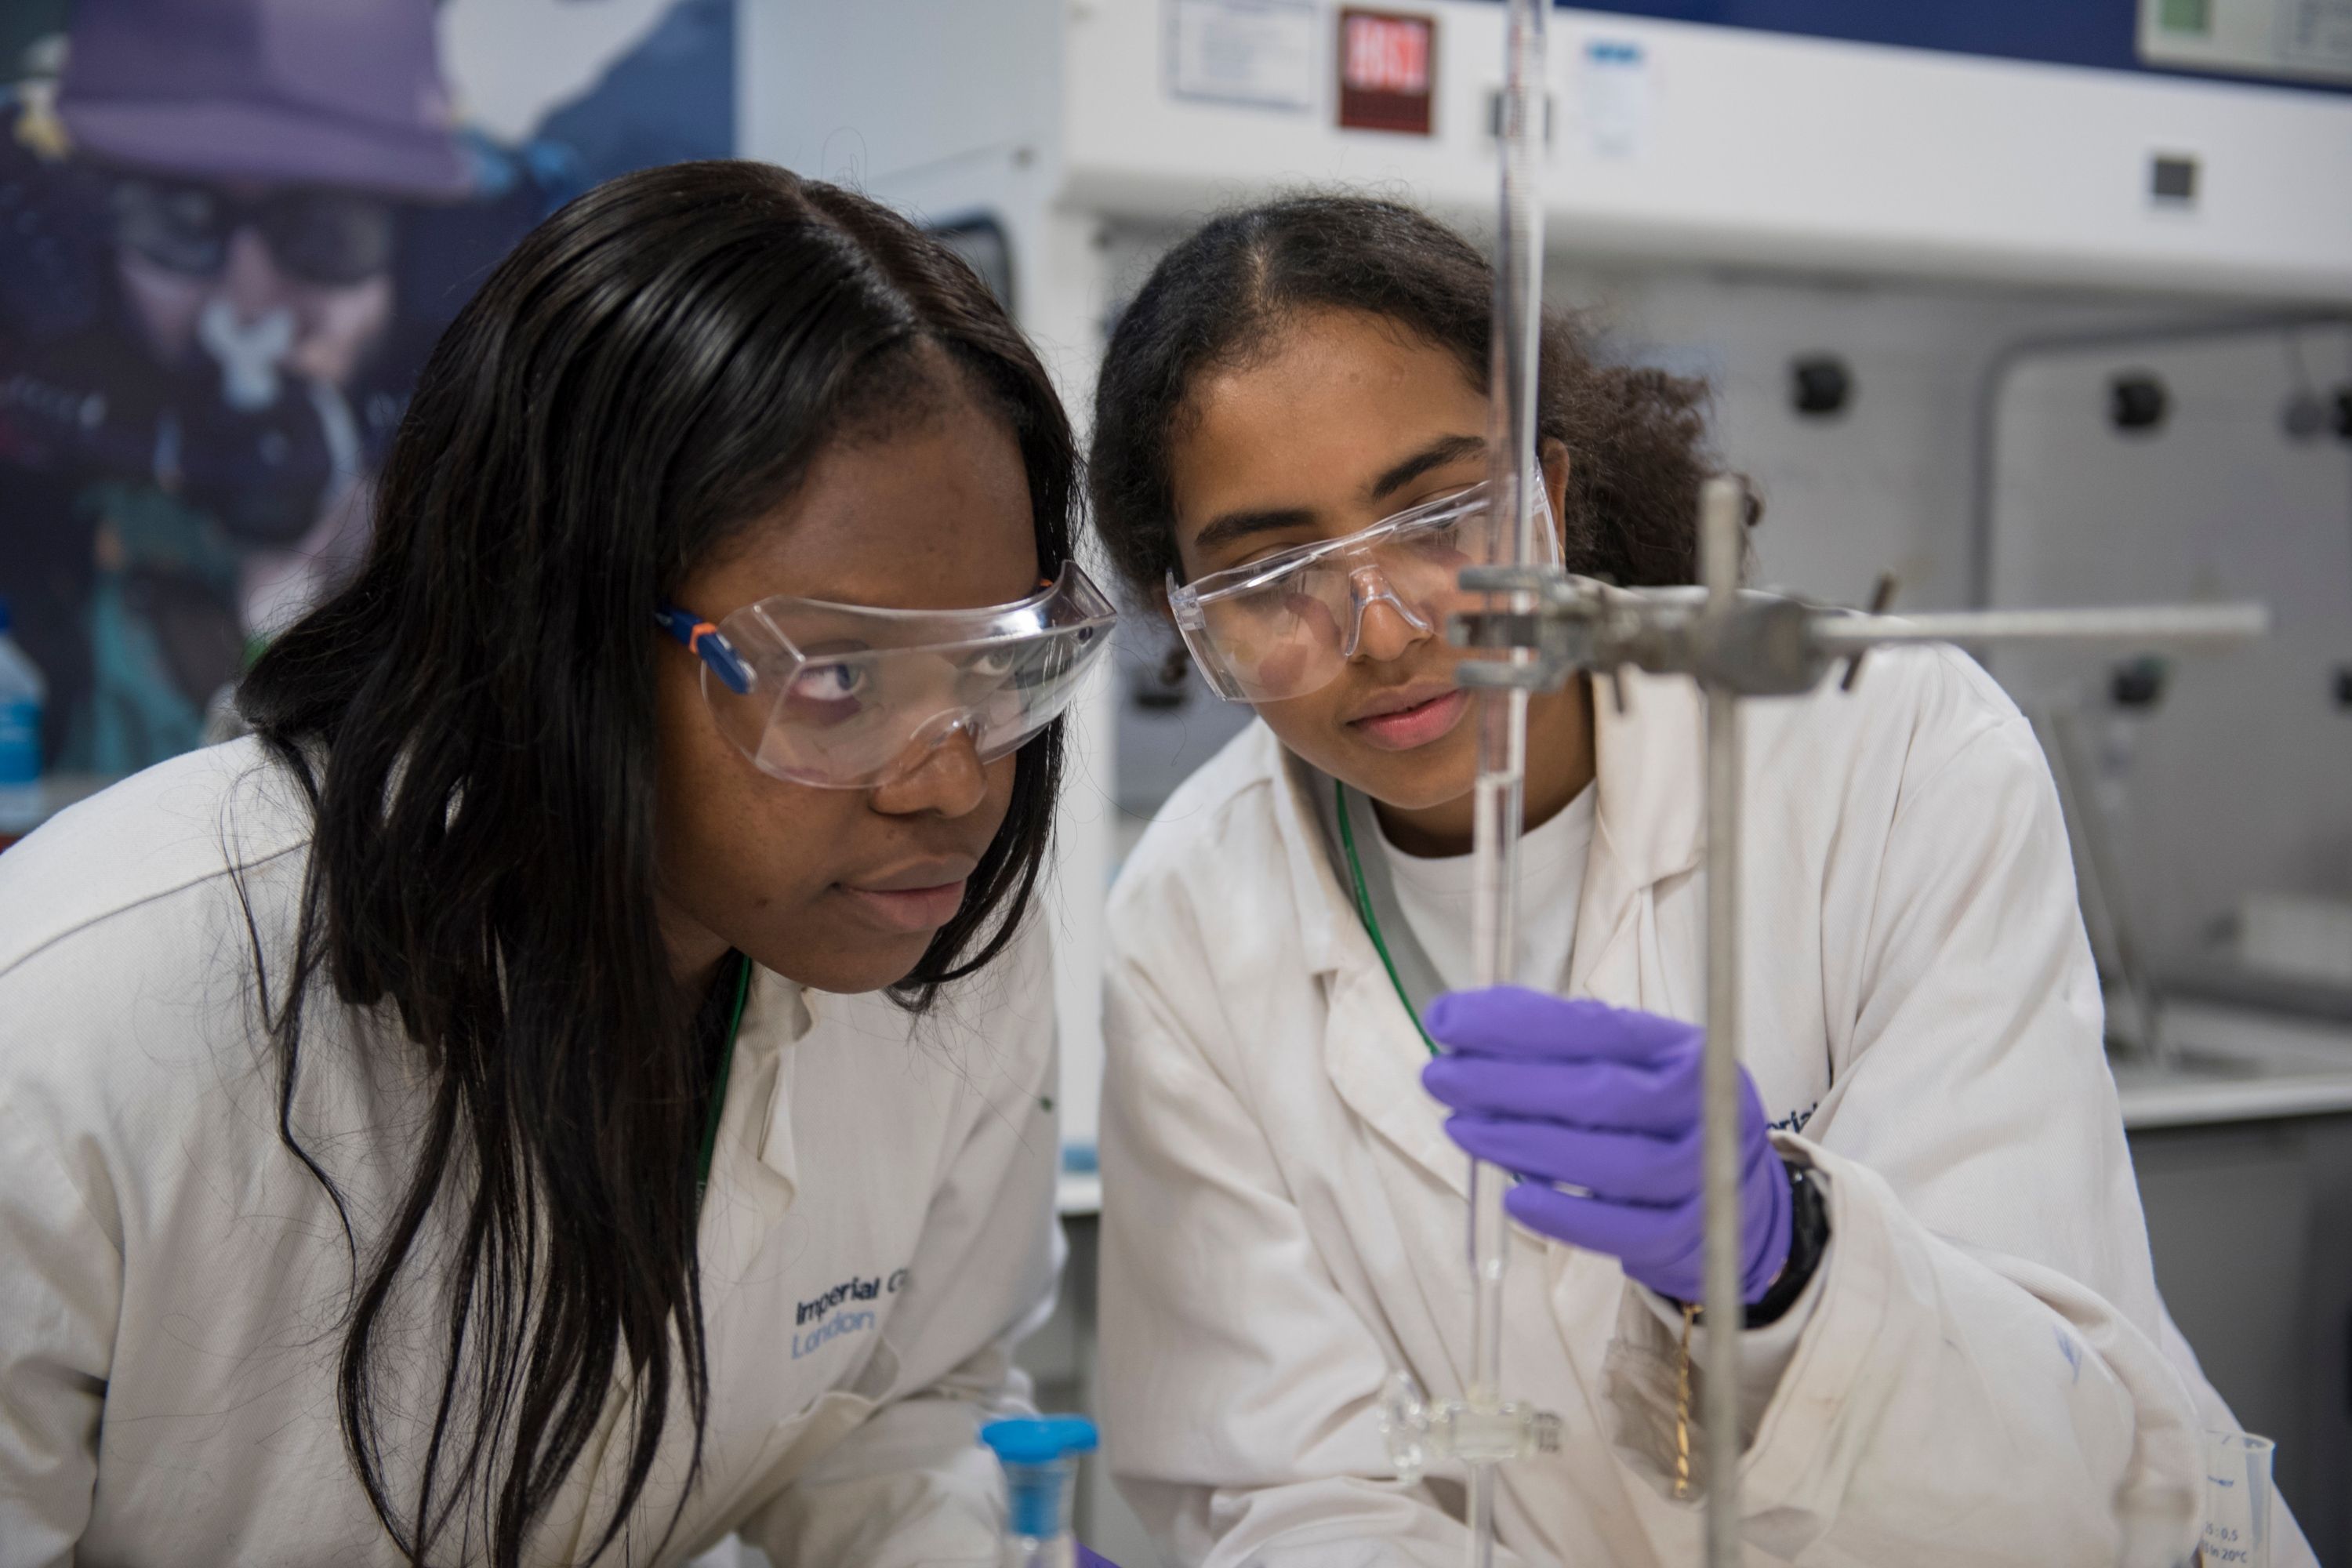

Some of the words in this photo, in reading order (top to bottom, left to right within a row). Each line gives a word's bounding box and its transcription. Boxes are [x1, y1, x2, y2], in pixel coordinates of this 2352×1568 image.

[796, 1276, 880, 1327] Imperial
[887, 1267, 912, 1294] C
[791, 1309, 876, 1360] London
